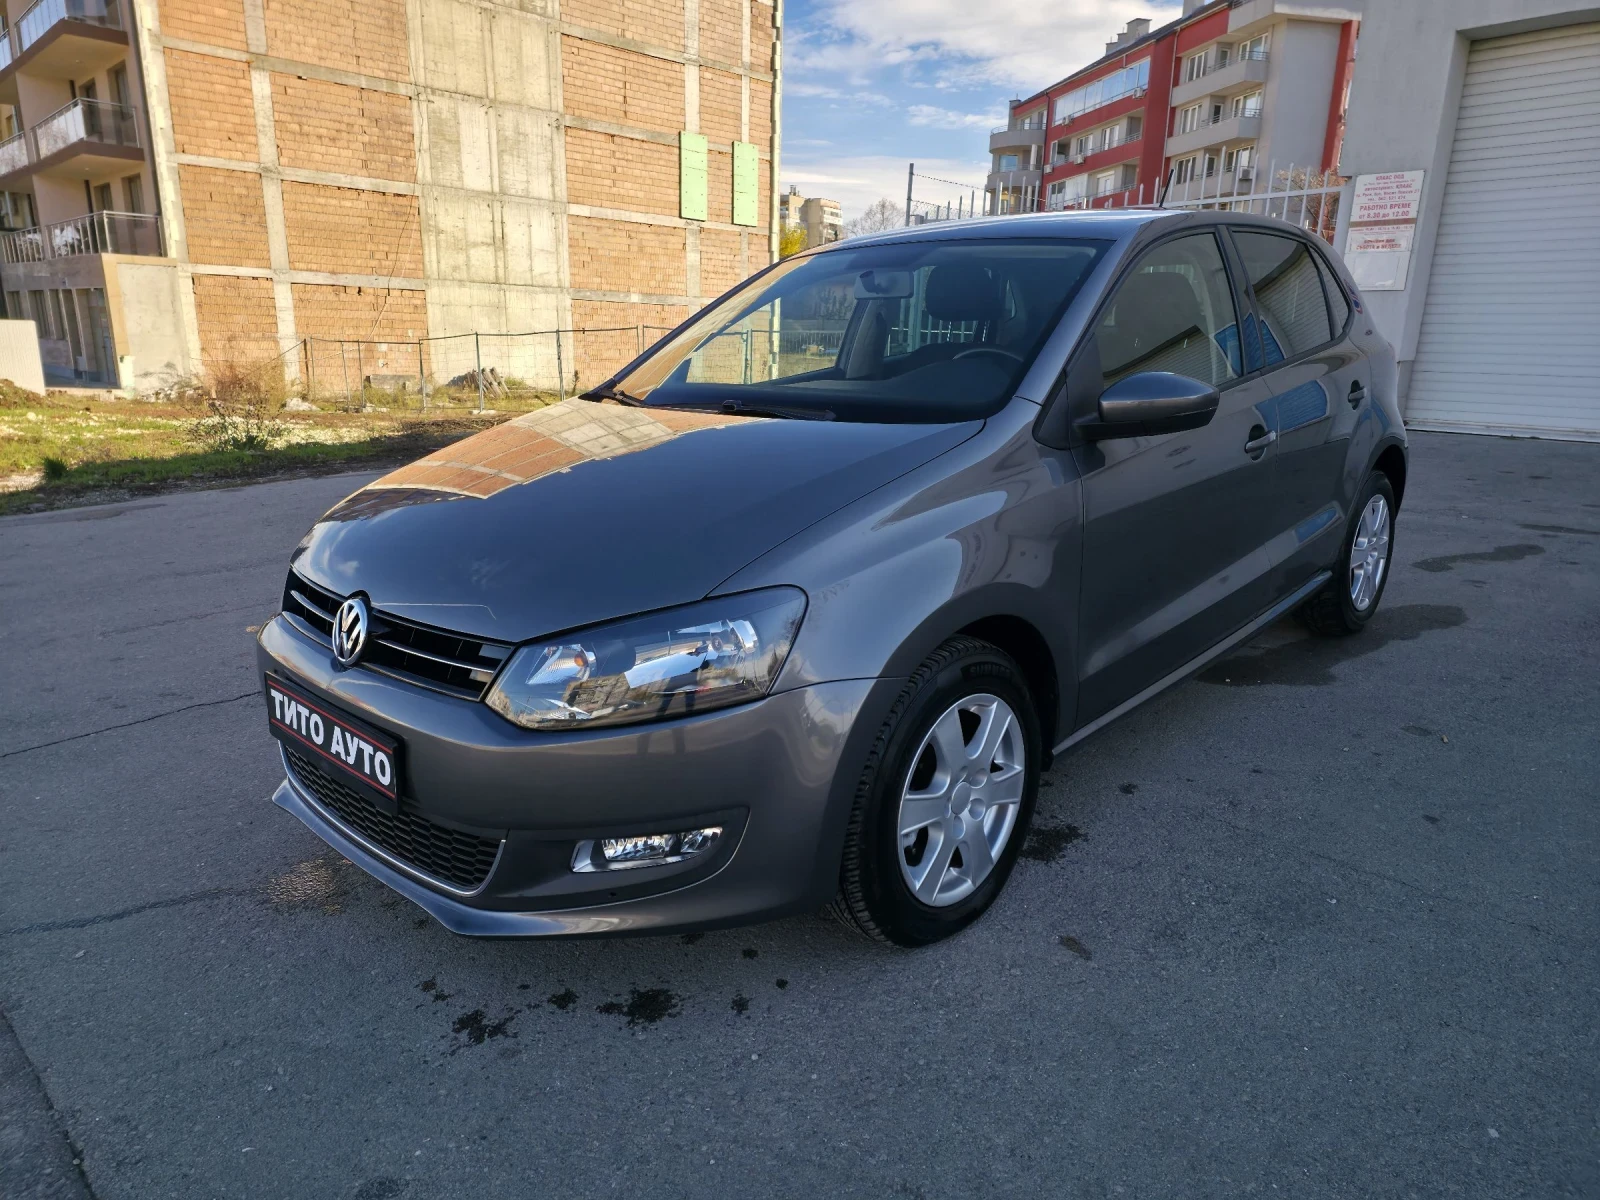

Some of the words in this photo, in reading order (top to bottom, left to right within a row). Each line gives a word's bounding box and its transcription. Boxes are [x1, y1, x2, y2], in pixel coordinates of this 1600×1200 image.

[1359, 203, 1387, 211] РАБОТНО
[270, 688, 325, 746] ТИТО
[330, 726, 392, 786] АУТО
